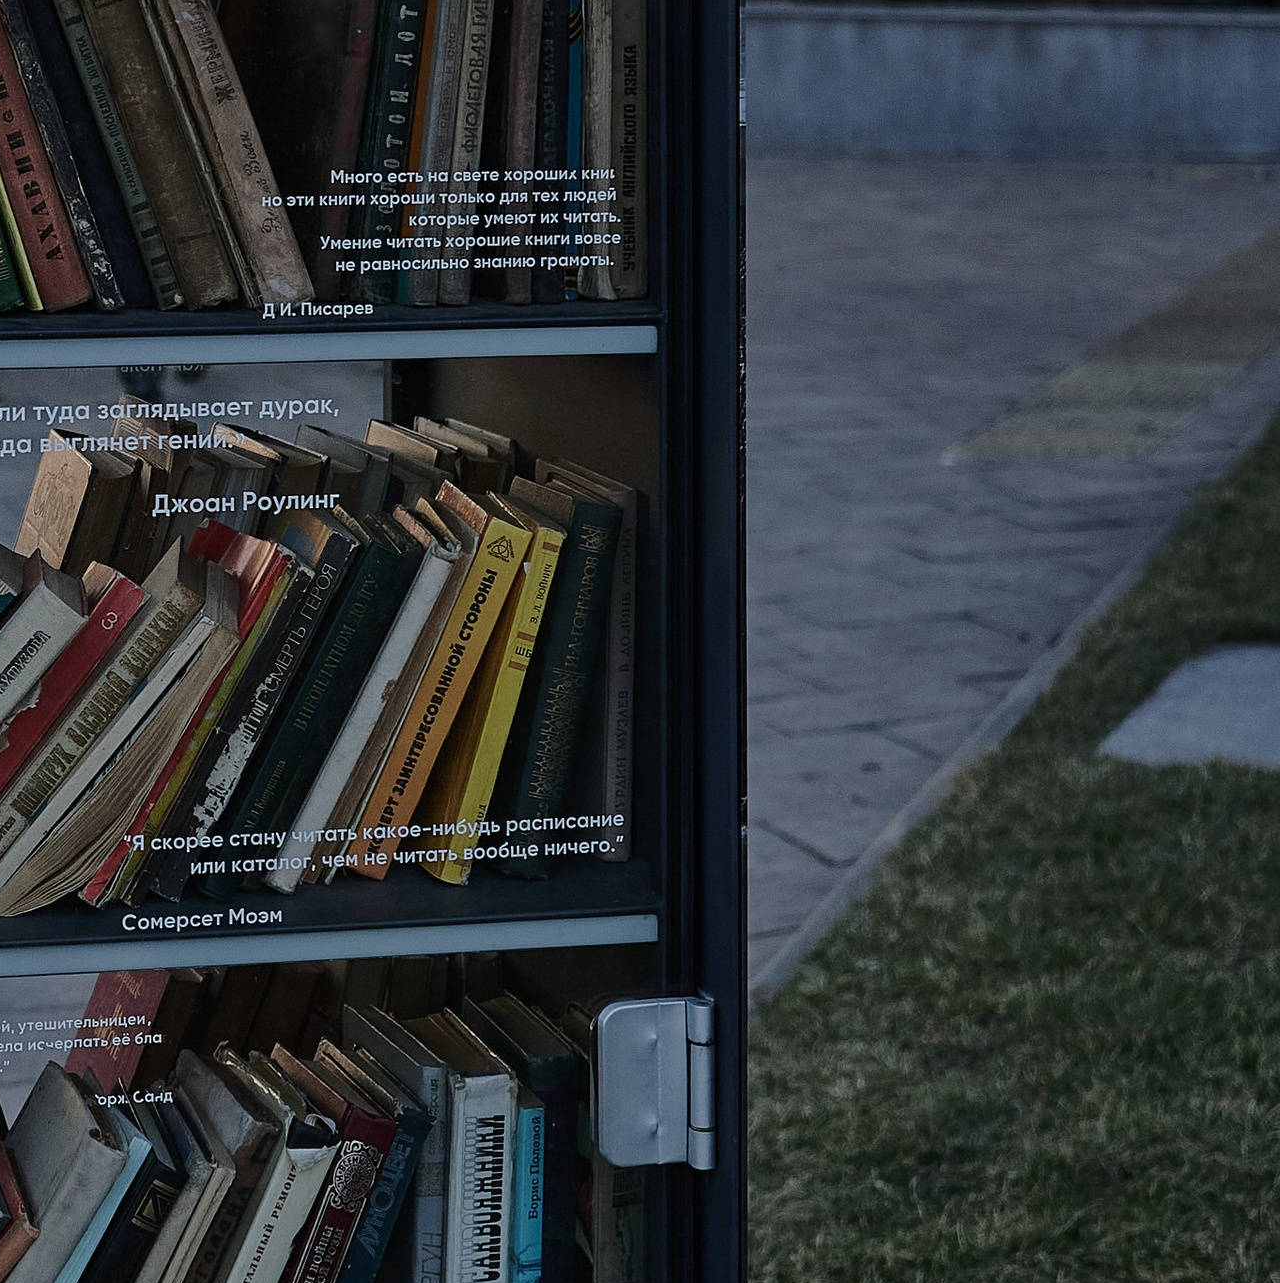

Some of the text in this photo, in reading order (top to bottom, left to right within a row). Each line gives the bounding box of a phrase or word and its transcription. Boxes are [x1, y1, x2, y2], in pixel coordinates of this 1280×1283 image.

[620, 44, 638, 271] УЧЕБНИК АНГЛИЙСКОГО ЯЗЫКА
[330, 169, 576, 185] Много есть на свете хороших
[261, 189, 559, 208] но эти книги хороши только для тех
[408, 210, 622, 229] которые умеют их читать.
[319, 232, 622, 252] Умение читать хорошие книги вовсе
[335, 253, 615, 274] не равносильно знанию грамоты.
[300, 302, 374, 319] Писарев
[33, 405, 90, 423] туда
[97, 400, 253, 420] заглядывает
[259, 399, 339, 419] дурак,
[40, 432, 149, 453] выглянет
[152, 490, 340, 518] Джоан Роулинг
[537, 562, 553, 603] ВОЙНИЧ
[265, 561, 338, 694] СМЕРТЬ ГЕРОЯ
[393, 568, 498, 797] ЗАИНТЕРЕСОВАННОЙ СТОРОНЫ
[150, 813, 625, 852] скорее стану читать какое-нибудь расписание
[190, 842, 539, 876] или каталог, чем не читать вообще
[122, 907, 283, 933] Сомерсет Моэм
[529, 1115, 542, 1221] Борис Полевой
[305, 1221, 334, 1274] ВОЙНЫ
